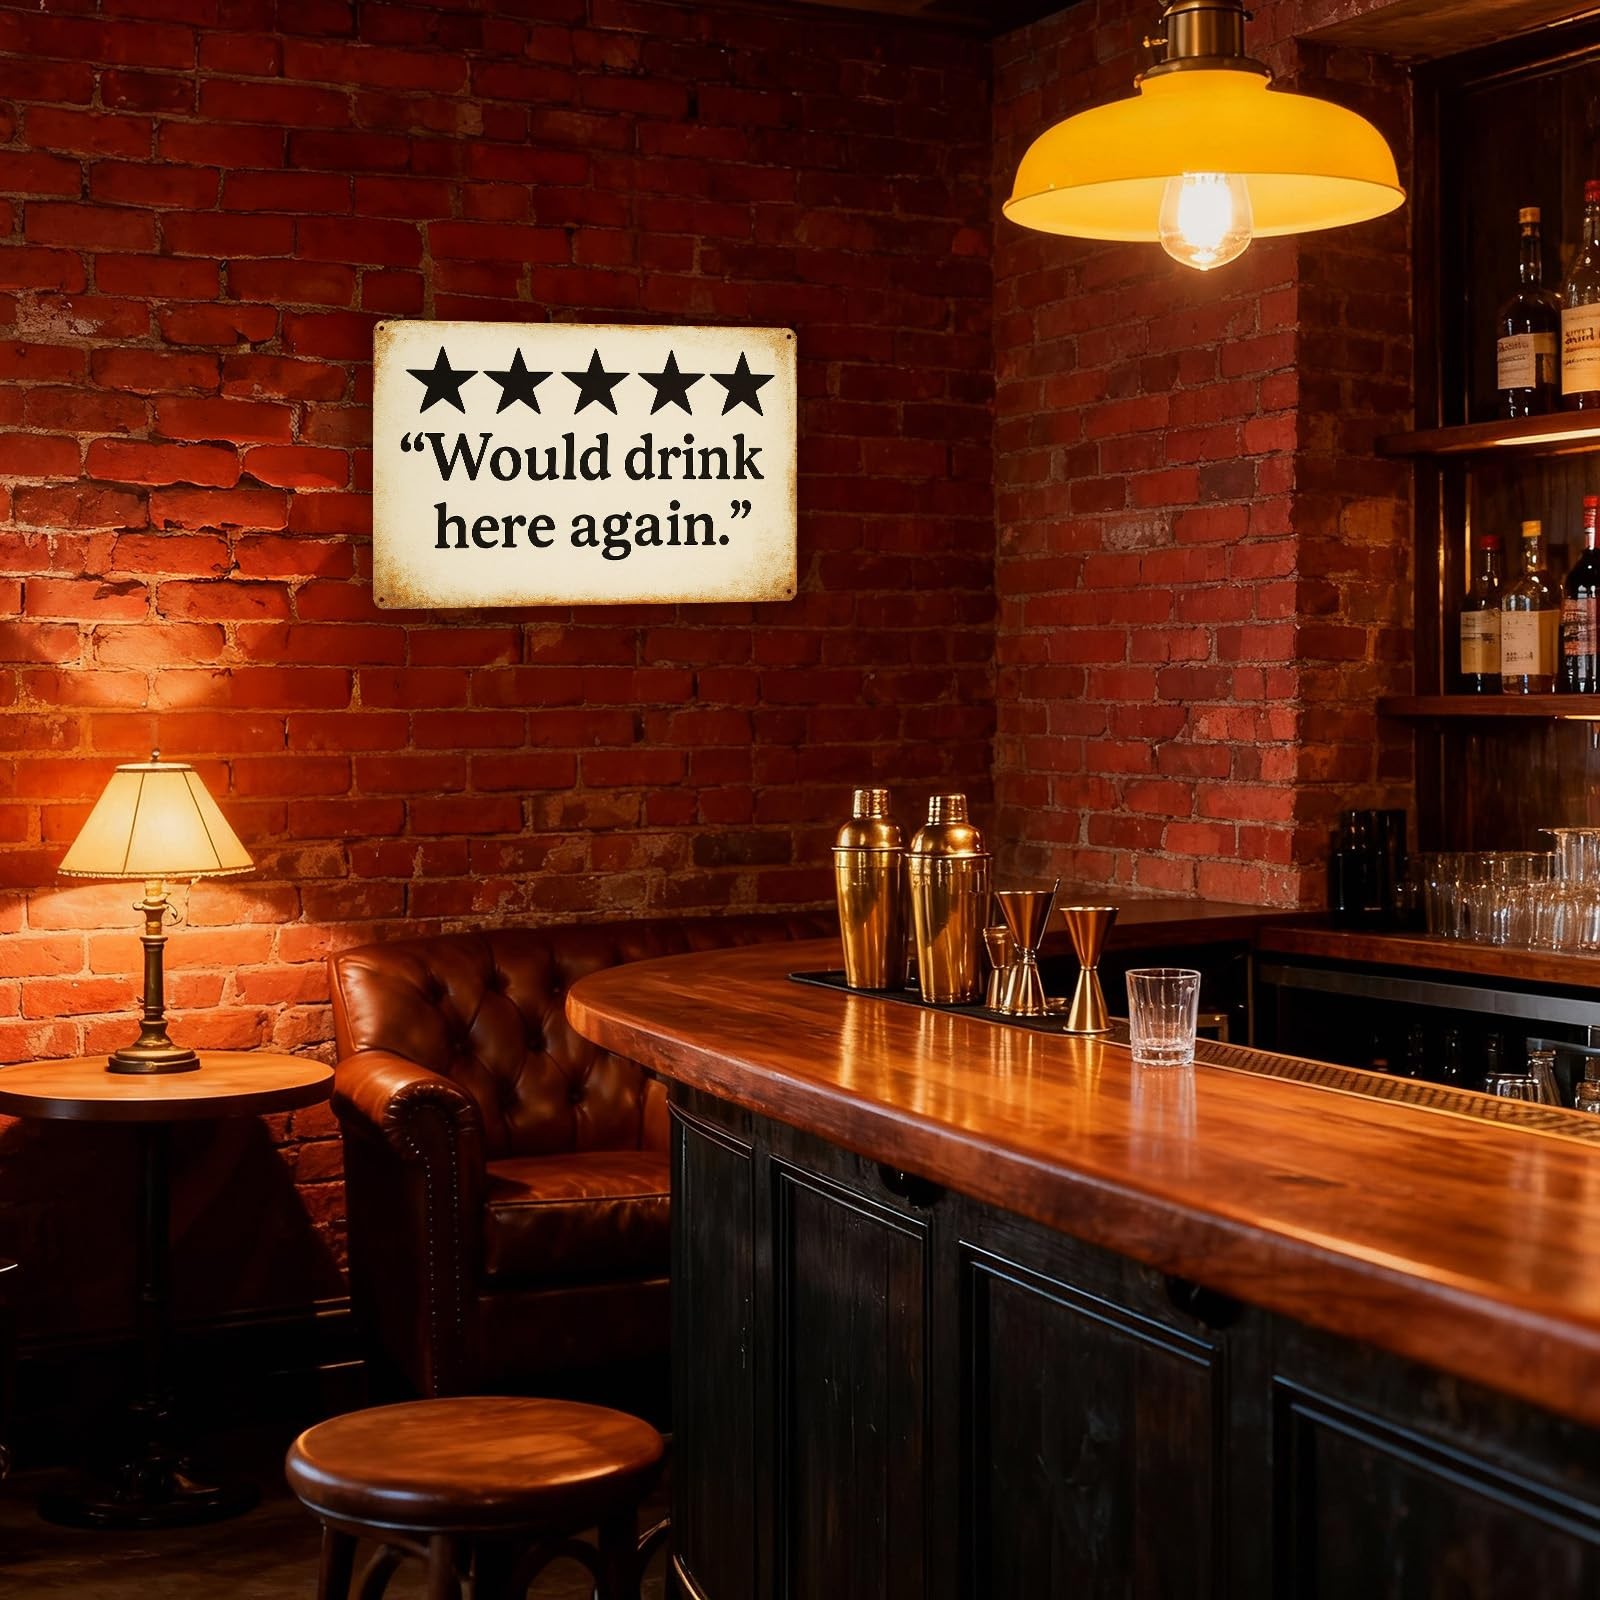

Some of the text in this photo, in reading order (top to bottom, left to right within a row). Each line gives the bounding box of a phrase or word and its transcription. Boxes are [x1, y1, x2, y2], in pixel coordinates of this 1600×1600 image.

[400, 431, 765, 482] “Would drink
[433, 499, 752, 561] here again.”
